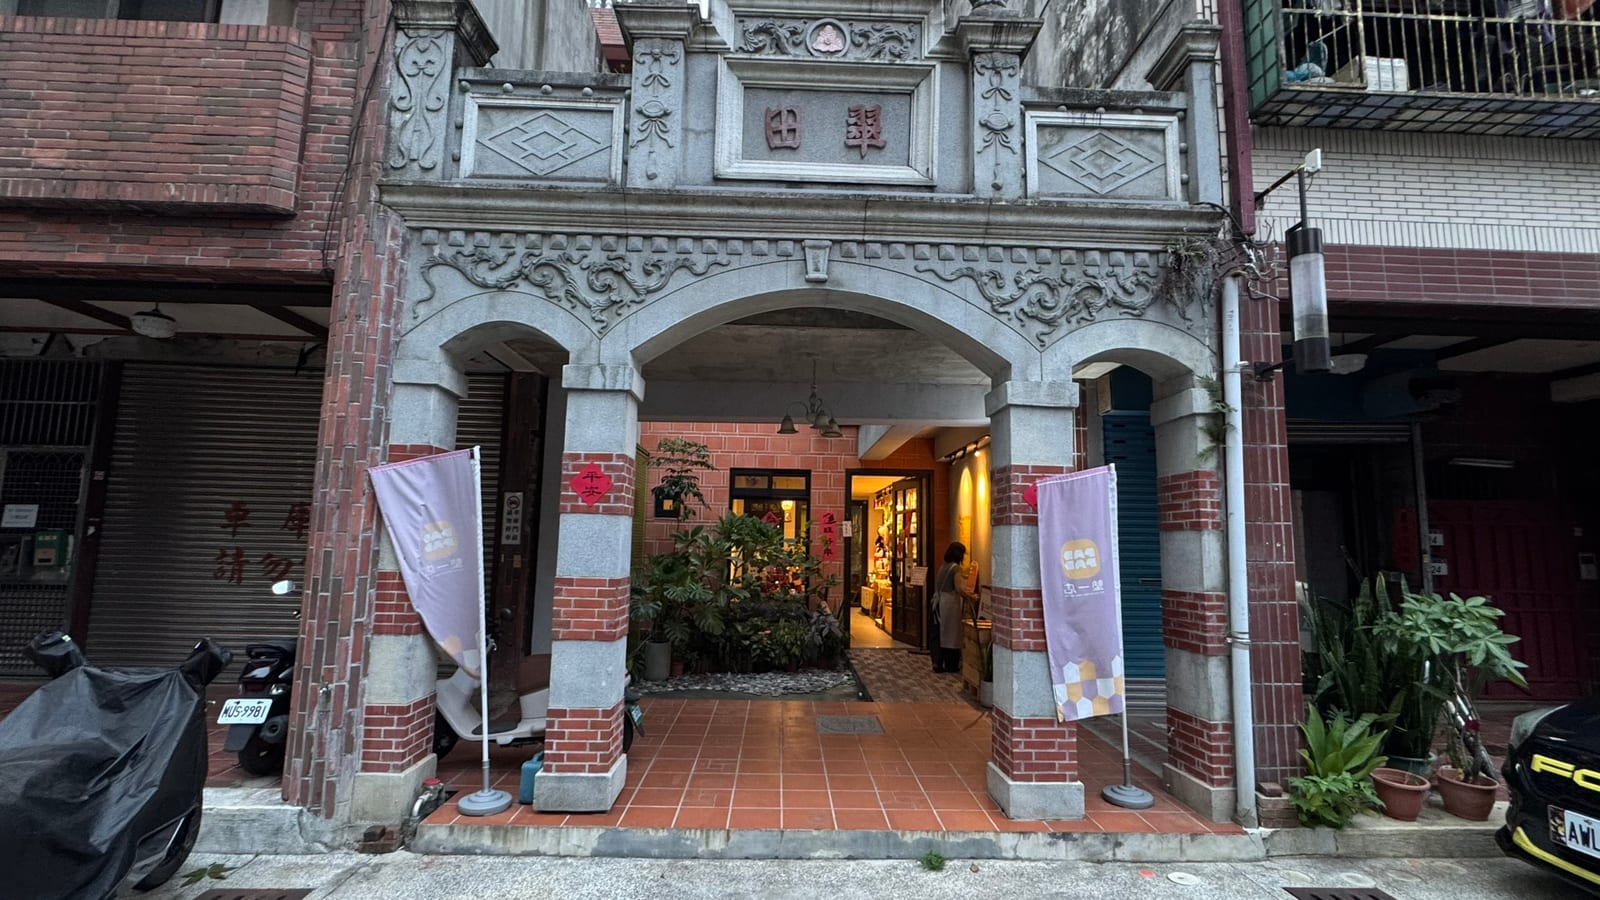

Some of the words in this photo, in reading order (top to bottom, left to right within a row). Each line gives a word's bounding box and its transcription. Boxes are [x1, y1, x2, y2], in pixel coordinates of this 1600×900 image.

[581, 471, 603, 498] 平安
[220, 500, 310, 539] 車庫
[213, 546, 306, 583] 請勿
